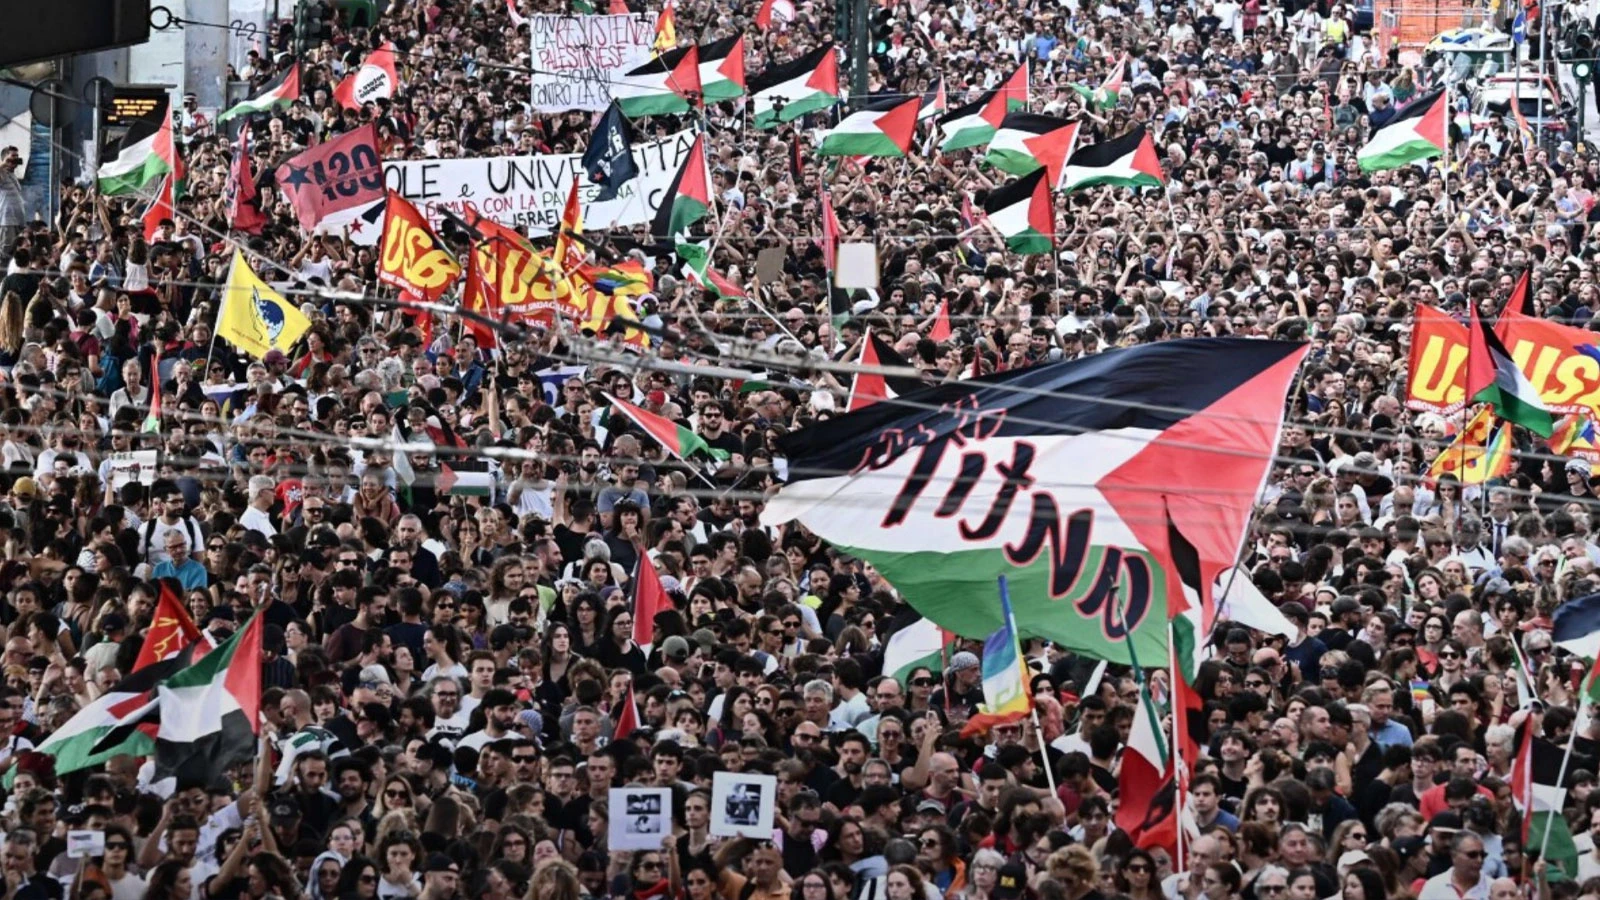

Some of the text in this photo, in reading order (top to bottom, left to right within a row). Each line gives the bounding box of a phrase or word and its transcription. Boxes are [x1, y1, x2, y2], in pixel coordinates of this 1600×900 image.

[483, 196, 513, 214] CON
[520, 193, 536, 211] LA
[383, 215, 460, 289] USB
